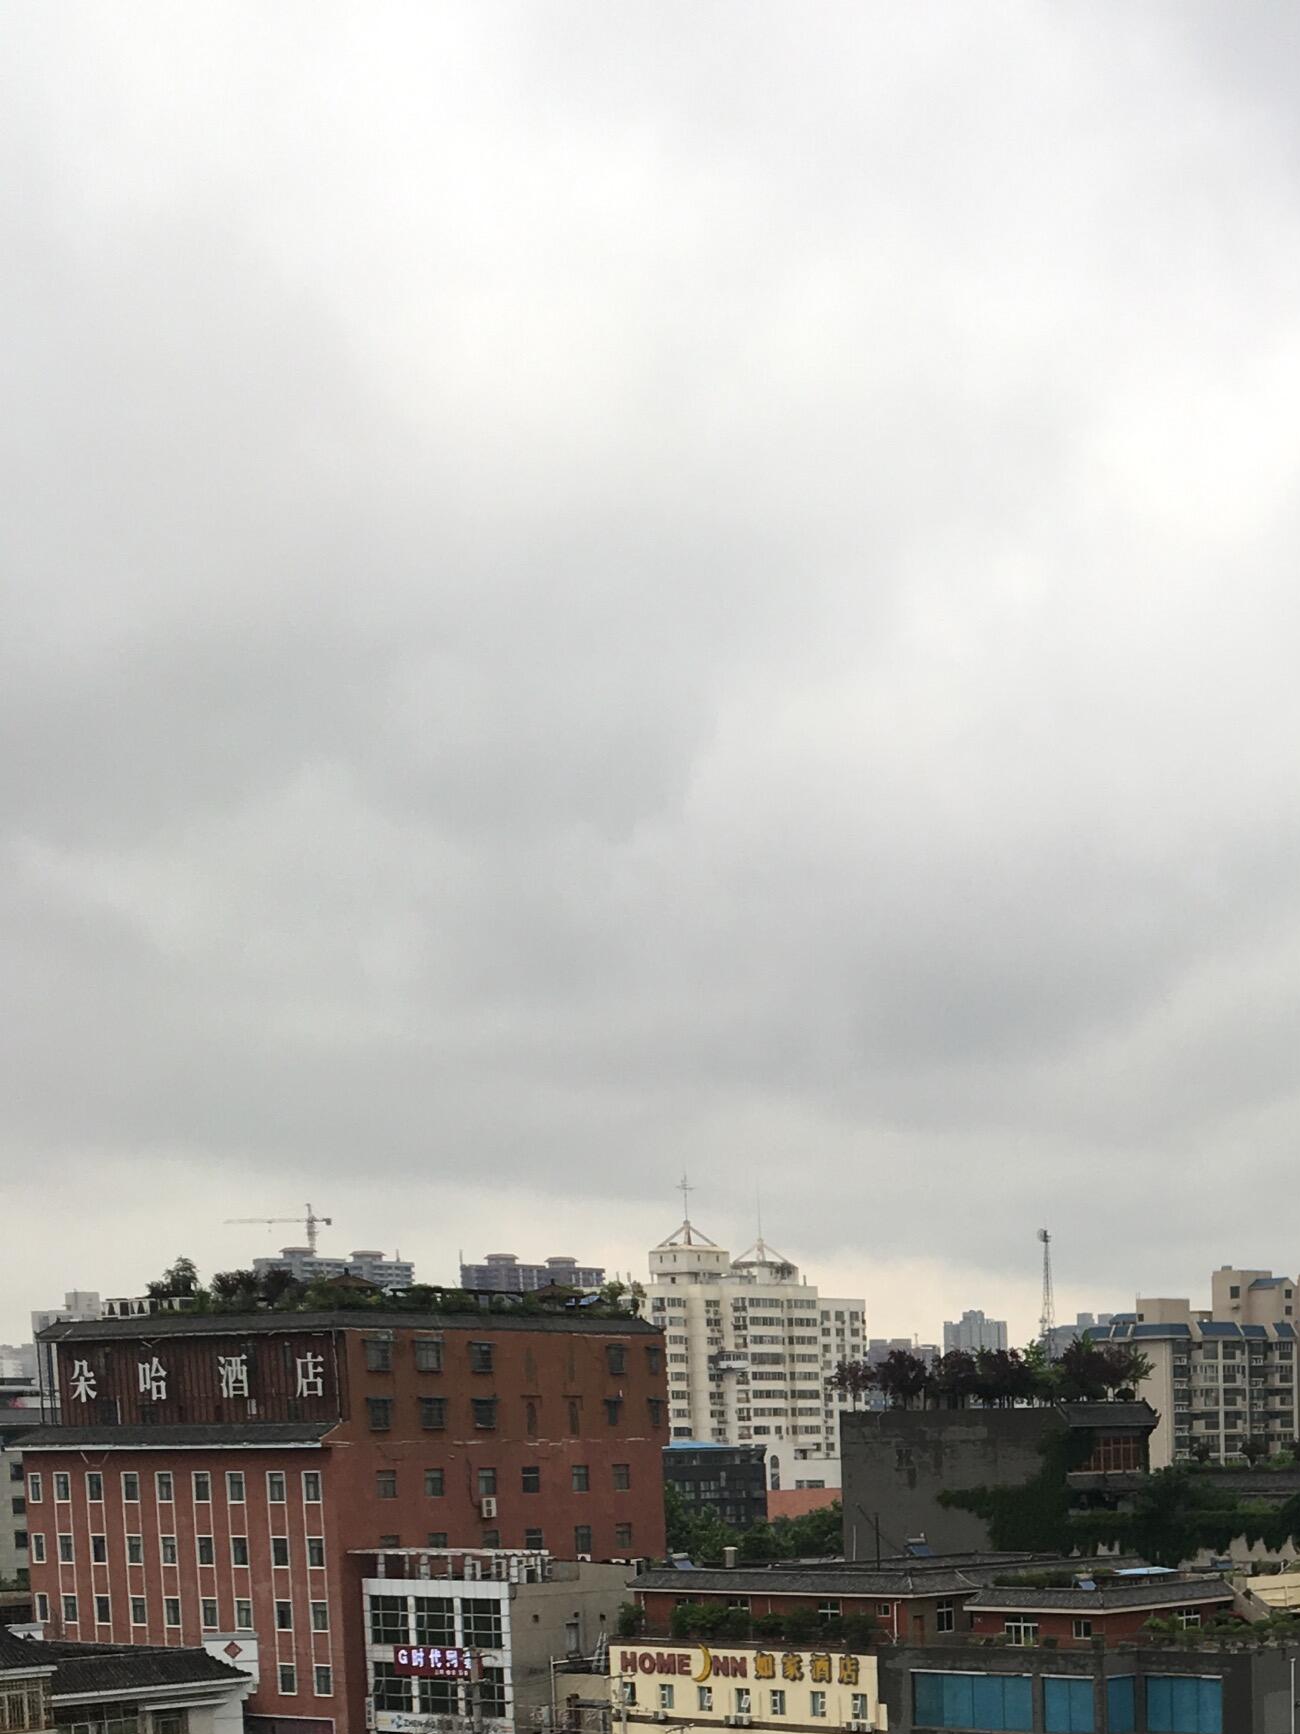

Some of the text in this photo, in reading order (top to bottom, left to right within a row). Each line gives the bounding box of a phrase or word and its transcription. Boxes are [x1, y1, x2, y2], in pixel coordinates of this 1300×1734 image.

[69, 1352, 324, 1403] 朵哈酒店
[620, 1651, 691, 1675] HOME
[754, 1650, 860, 1685] 如家酒店
